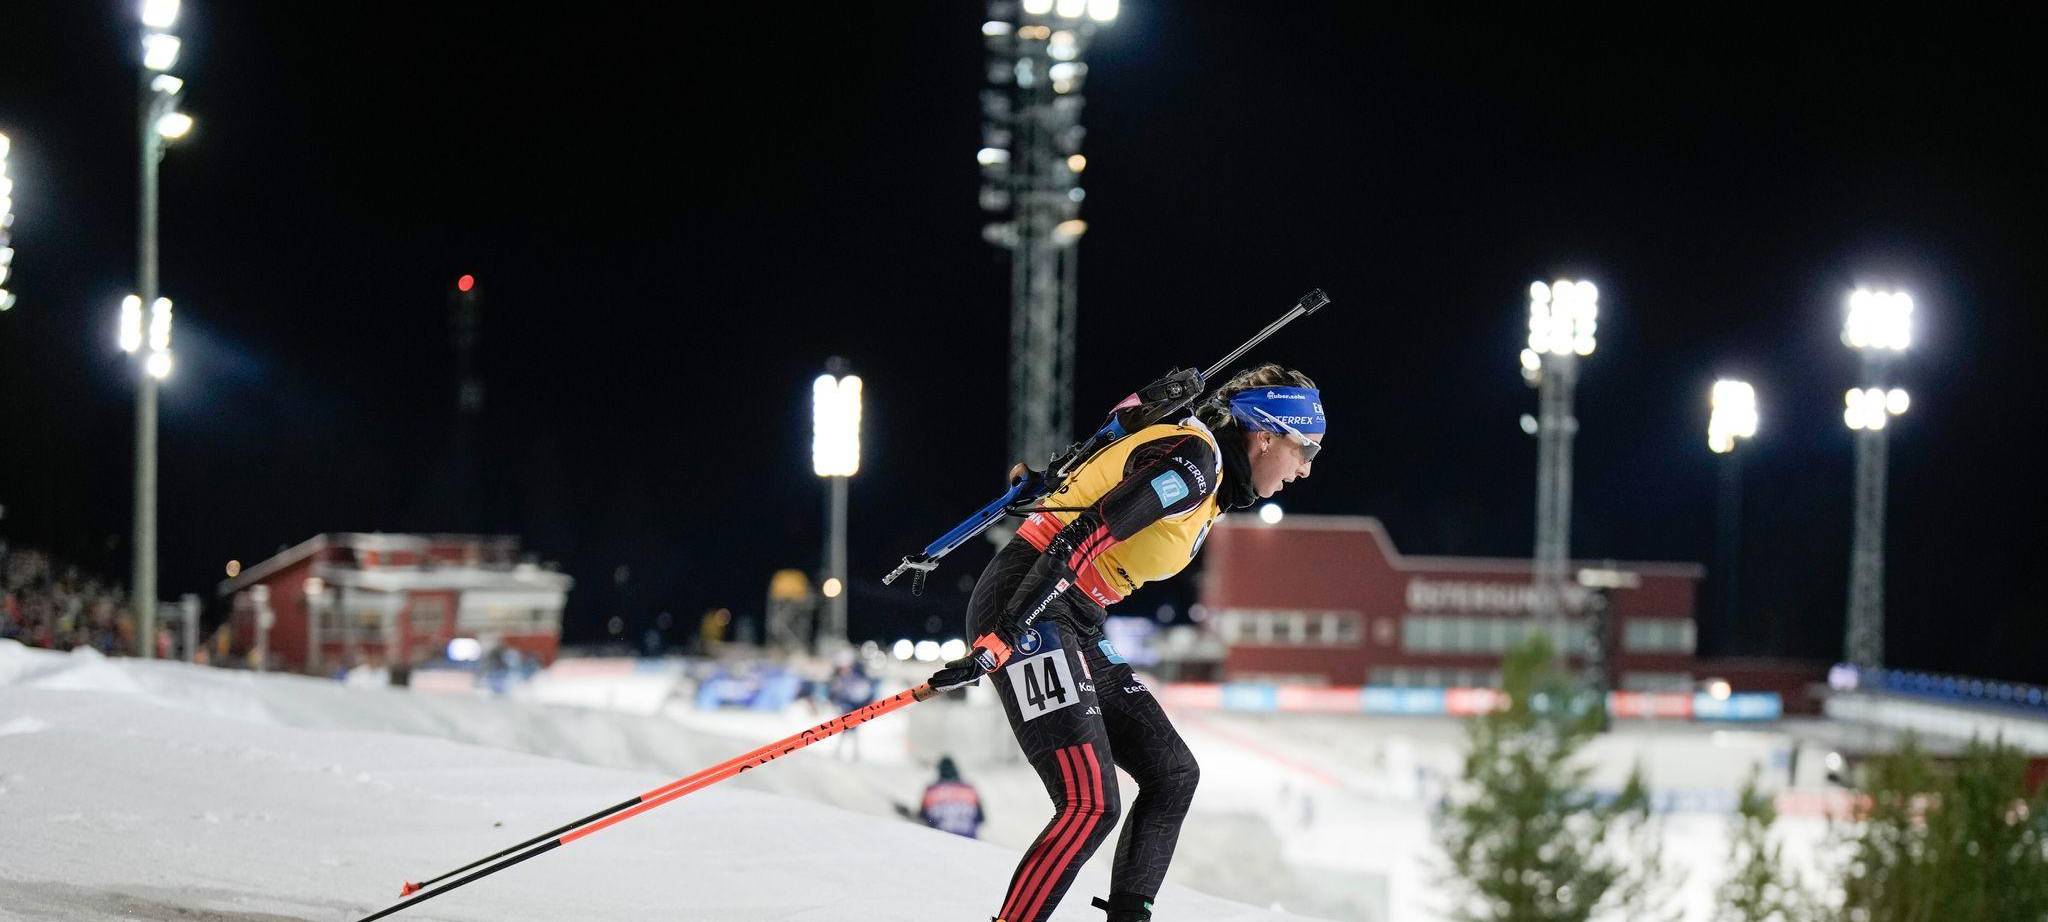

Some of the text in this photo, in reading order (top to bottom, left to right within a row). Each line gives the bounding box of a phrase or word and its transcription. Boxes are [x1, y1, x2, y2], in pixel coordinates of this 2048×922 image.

[1184, 460, 1207, 496] TERREX
[1025, 589, 1061, 626] Kaufland
[1024, 656, 1067, 712] 44
